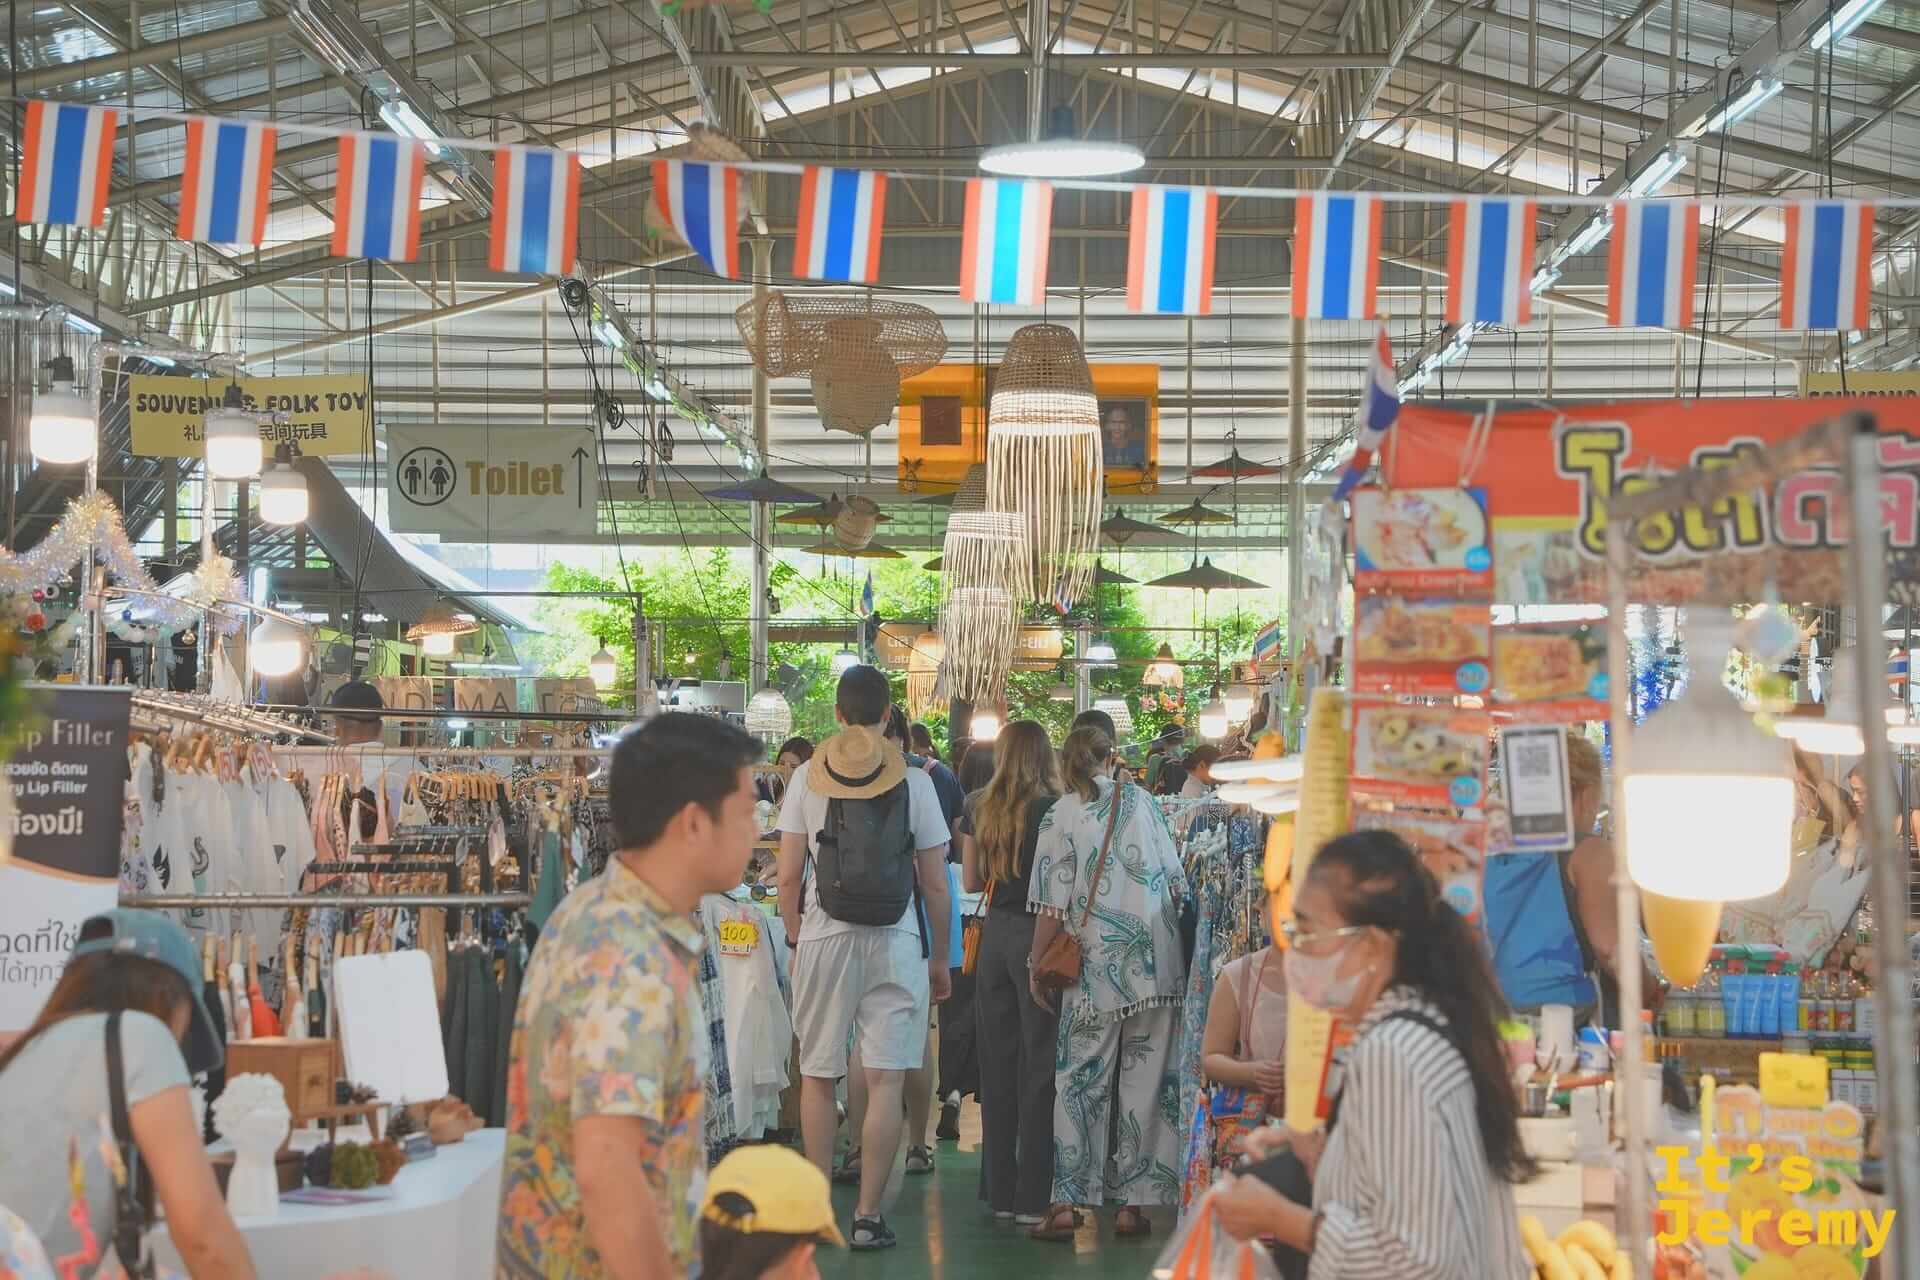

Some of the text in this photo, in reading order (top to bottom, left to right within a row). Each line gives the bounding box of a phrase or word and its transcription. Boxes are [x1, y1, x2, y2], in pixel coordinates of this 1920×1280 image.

[136, 393, 224, 415] SOUVENI
[265, 394, 319, 413] FOLK
[325, 391, 368, 411] TOY
[465, 461, 565, 496] Toilet
[53, 719, 114, 746] Filler
[27, 780, 50, 797] Lip
[52, 780, 88, 794] Filler
